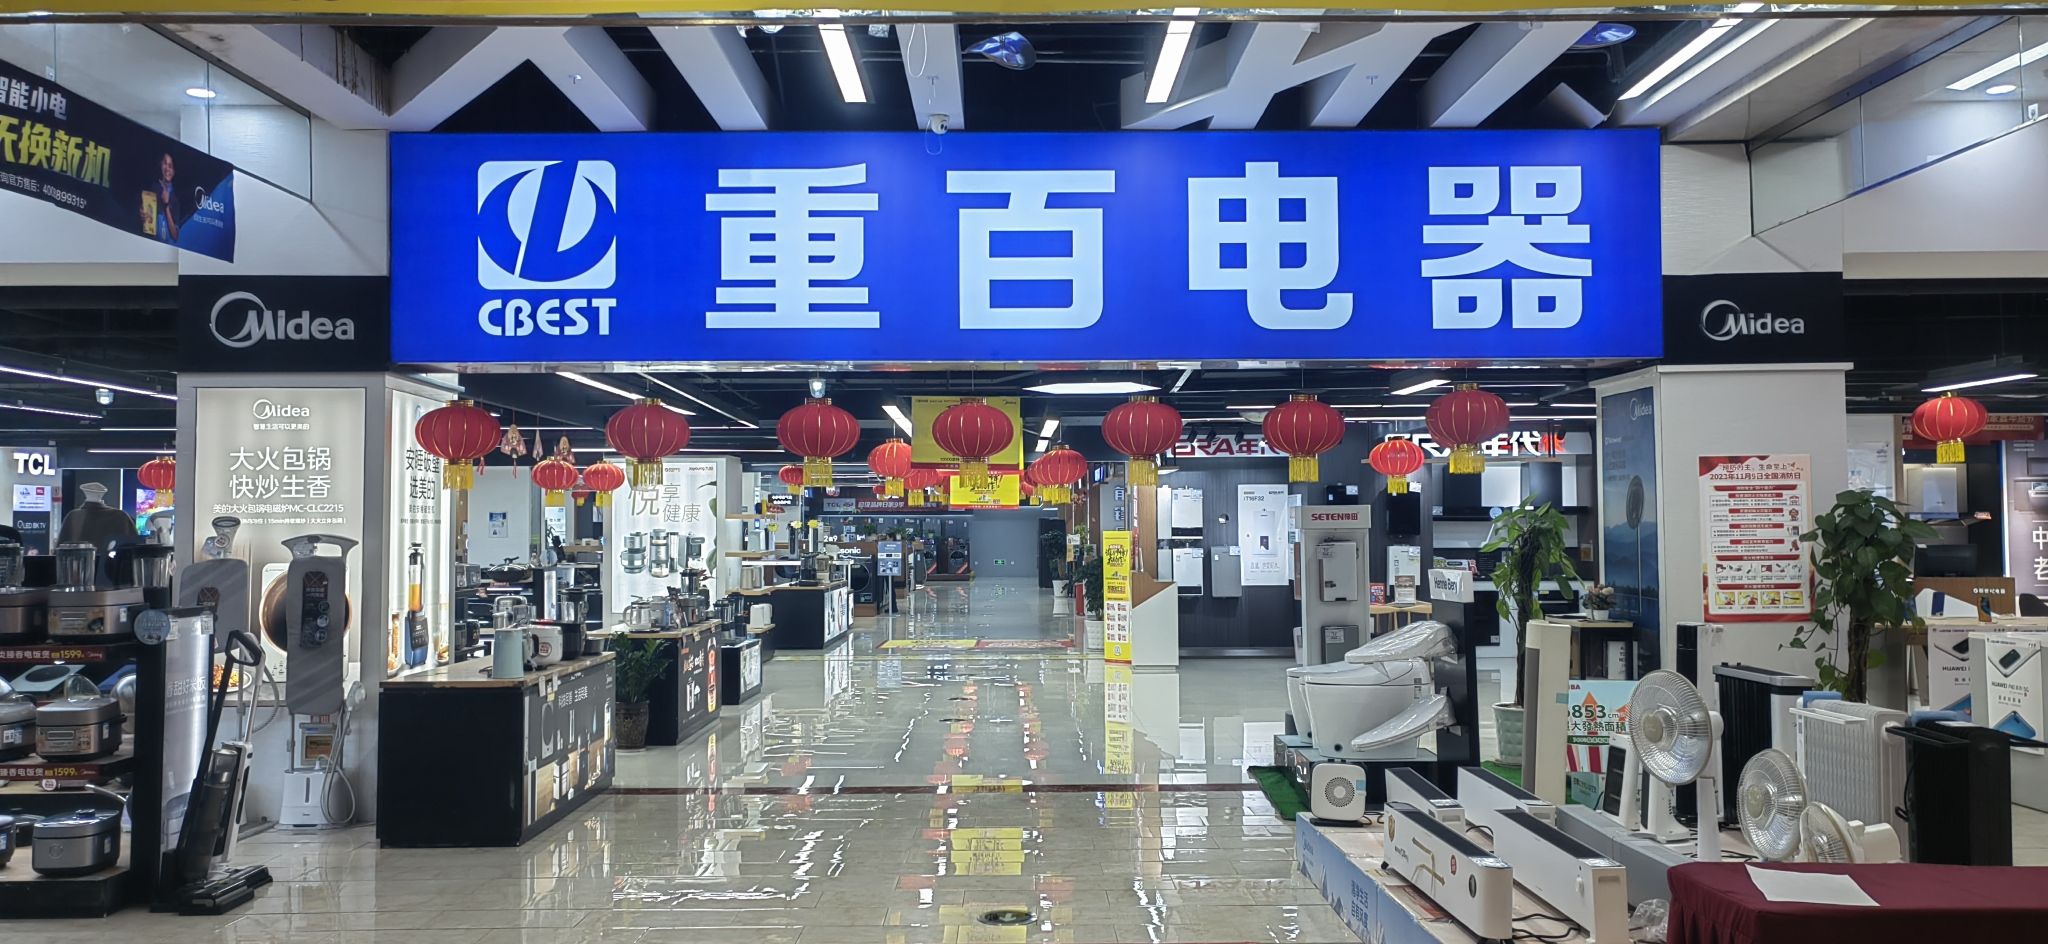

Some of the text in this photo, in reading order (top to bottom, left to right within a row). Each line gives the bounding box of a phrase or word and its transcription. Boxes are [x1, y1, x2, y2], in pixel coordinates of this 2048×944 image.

[0, 115, 111, 188] 天换新机
[194, 185, 224, 214] Midea
[705, 162, 1592, 330] 重百电器
[210, 291, 355, 348] Midea
[478, 298, 616, 336] CBEST
[1701, 299, 1805, 341] Midea
[253, 399, 310, 419] Midea
[1630, 398, 1653, 420] Midea
[13, 453, 56, 476] TCL
[229, 447, 332, 471] 大火包锅
[229, 474, 332, 499] 快炒生香
[410, 475, 435, 500] 选美的
[212, 503, 344, 514] 美的大火包锅电磁炉MC-CLC2215
[662, 504, 701, 523] 健康
[60, 649, 82, 659] 1599
[1568, 704, 1607, 719] 853
[1568, 721, 1627, 732] 大發熱面積
[53, 768, 76, 777] 1599
